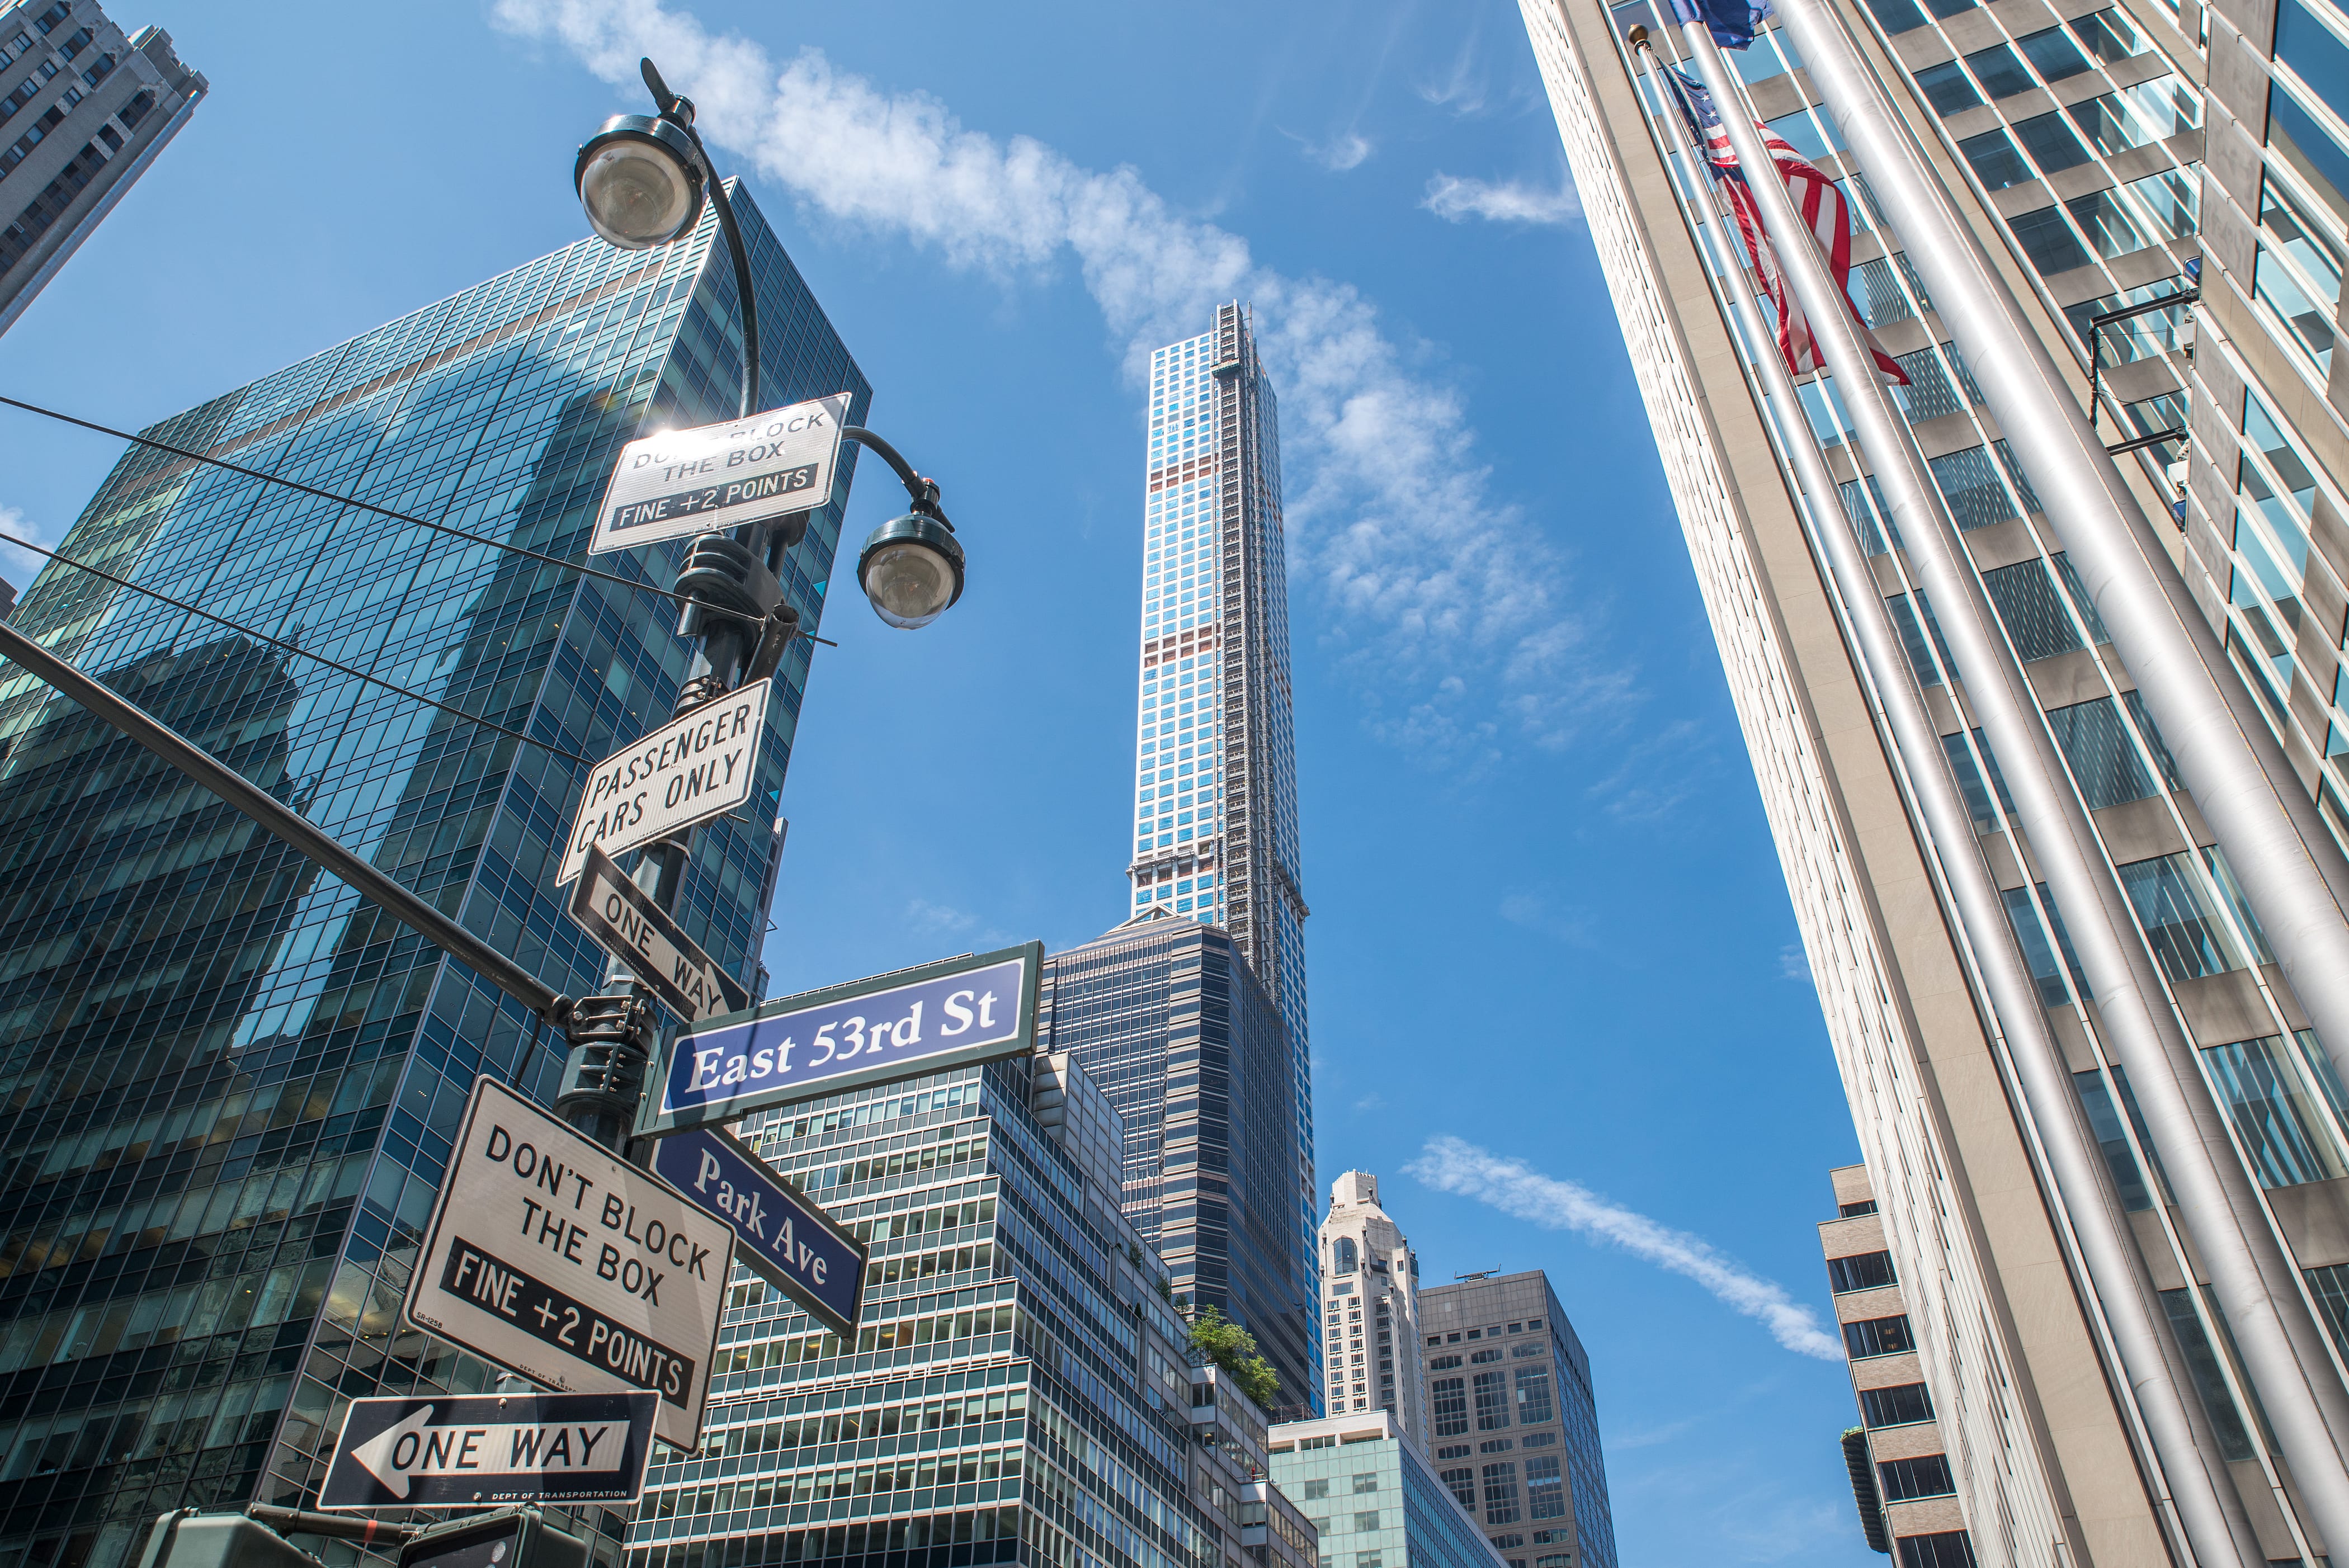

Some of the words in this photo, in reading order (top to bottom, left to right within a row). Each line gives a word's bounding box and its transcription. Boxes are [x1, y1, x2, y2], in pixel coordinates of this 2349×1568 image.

[619, 499, 671, 527] FINE
[679, 488, 717, 511] +2
[726, 469, 808, 504] POINTS
[663, 456, 718, 482] THE
[727, 440, 785, 468] BOX
[590, 703, 751, 809] PASSENGER
[577, 791, 647, 853] CARS
[664, 747, 743, 809] ONLY
[639, 817, 683, 838] TRANSPORTATION
[605, 937, 644, 976] TRANSPORTATION
[606, 893, 656, 958] ONE
[675, 955, 722, 1016] WAY
[685, 1037, 796, 1093] East
[809, 1001, 924, 1068] 53rd
[940, 990, 998, 1036] St
[485, 1123, 593, 1210] DON'T
[601, 1192, 711, 1282] BLOCK
[694, 1147, 767, 1239] Park
[772, 1216, 828, 1286] Ave
[521, 1197, 588, 1265] THE
[596, 1242, 665, 1307] BOX
[416, 1311, 443, 1329] SR-1258
[453, 1250, 526, 1317] FINE
[534, 1297, 582, 1346] +2
[587, 1324, 683, 1396] POINTS
[520, 1364, 536, 1374] DEPT
[392, 1429, 487, 1471] ONE
[510, 1426, 609, 1468] WAY
[539, 1490, 627, 1499] TRANSPORTATION
